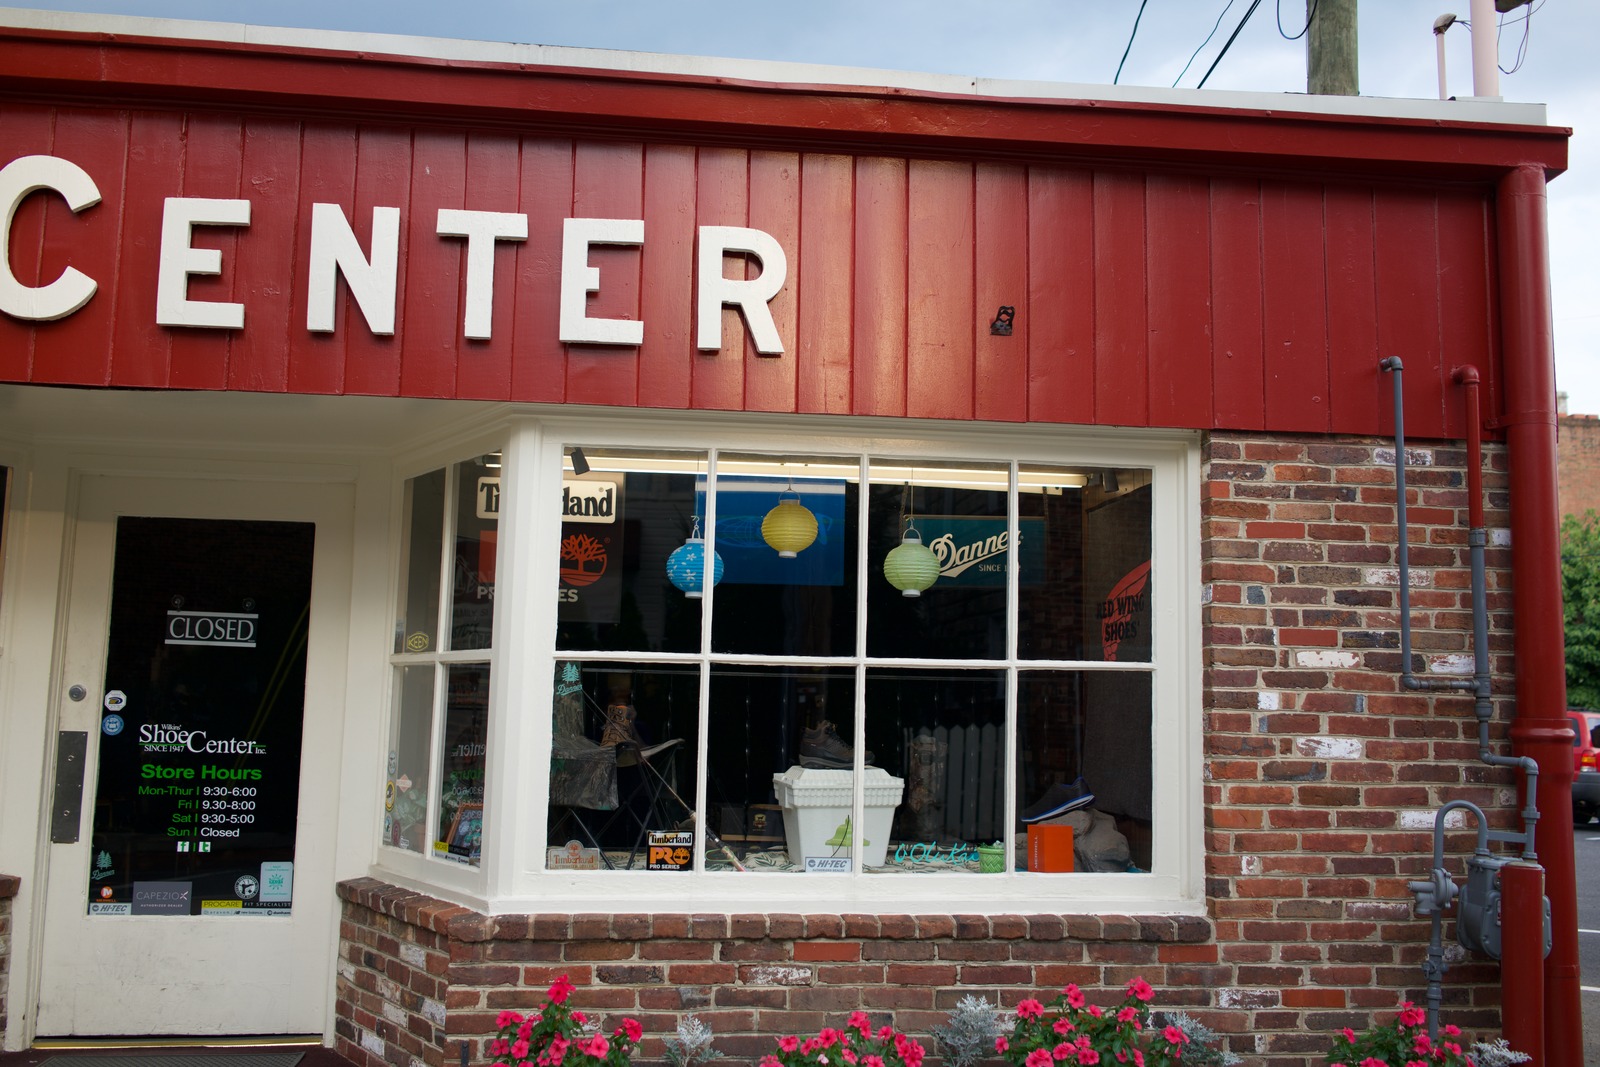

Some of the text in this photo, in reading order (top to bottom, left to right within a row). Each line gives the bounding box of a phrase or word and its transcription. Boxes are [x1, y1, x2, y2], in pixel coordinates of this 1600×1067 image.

[0, 154, 788, 356] CENTER
[928, 530, 1022, 577] Danne
[978, 564, 1002, 572] SINCE
[1097, 593, 1145, 620] RED WING
[169, 616, 255, 642] CLOSED
[1105, 621, 1138, 642] SHOES
[408, 635, 428, 649] KEEN
[138, 723, 190, 744] Shoe
[187, 731, 257, 754] Center
[255, 746, 267, 755] Inc.
[169, 745, 185, 753] 1947
[140, 764, 263, 780] Store Hours
[138, 785, 194, 796] Mon-Thur
[202, 786, 257, 797] 9:30-6:00
[178, 799, 193, 809] Fri
[171, 813, 192, 824] Sat
[201, 813, 255, 824] 9:30-5:00
[166, 826, 191, 837] Sun
[200, 827, 240, 838] Closed
[649, 833, 692, 844] Timberland
[553, 854, 595, 865] Timberland
[136, 891, 180, 901] CAPEZIO
[100, 904, 128, 912] HI-TEC
